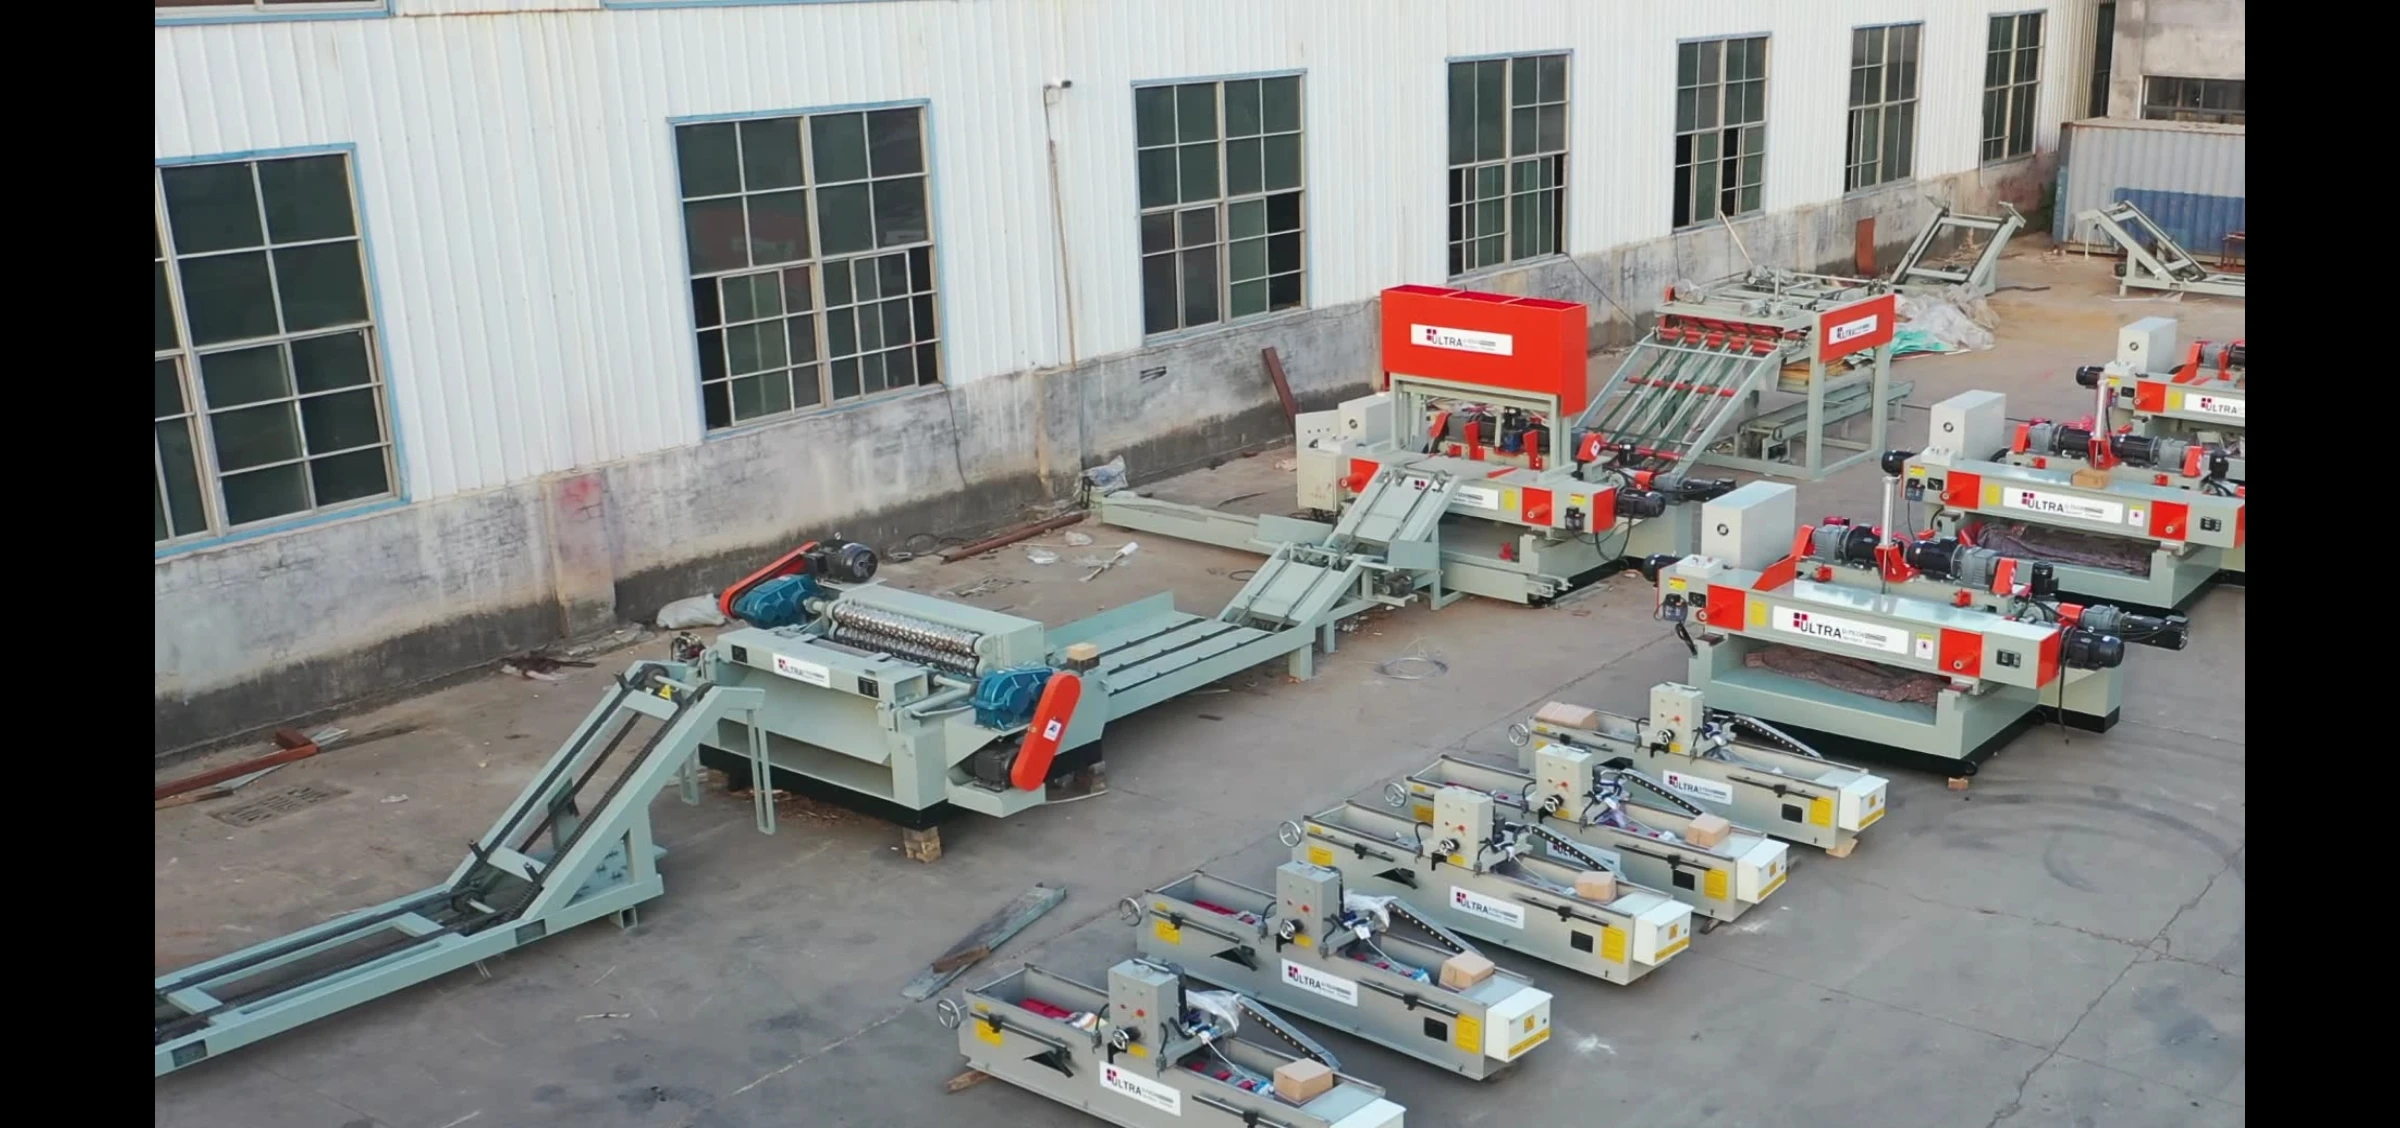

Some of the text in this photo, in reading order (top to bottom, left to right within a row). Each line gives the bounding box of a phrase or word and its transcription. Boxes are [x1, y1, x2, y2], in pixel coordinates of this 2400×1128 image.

[1432, 335, 1463, 347] ULTRA
[2206, 403, 2238, 414] ULTRA
[2027, 499, 2064, 513] ULTRA
[1801, 619, 1842, 639] ULTRA
[1673, 781, 1699, 793] ULTRA
[1461, 898, 1488, 913] ULTRA
[1294, 972, 1322, 989] ULTRA
[1112, 1078, 1142, 1095] ULTRA
